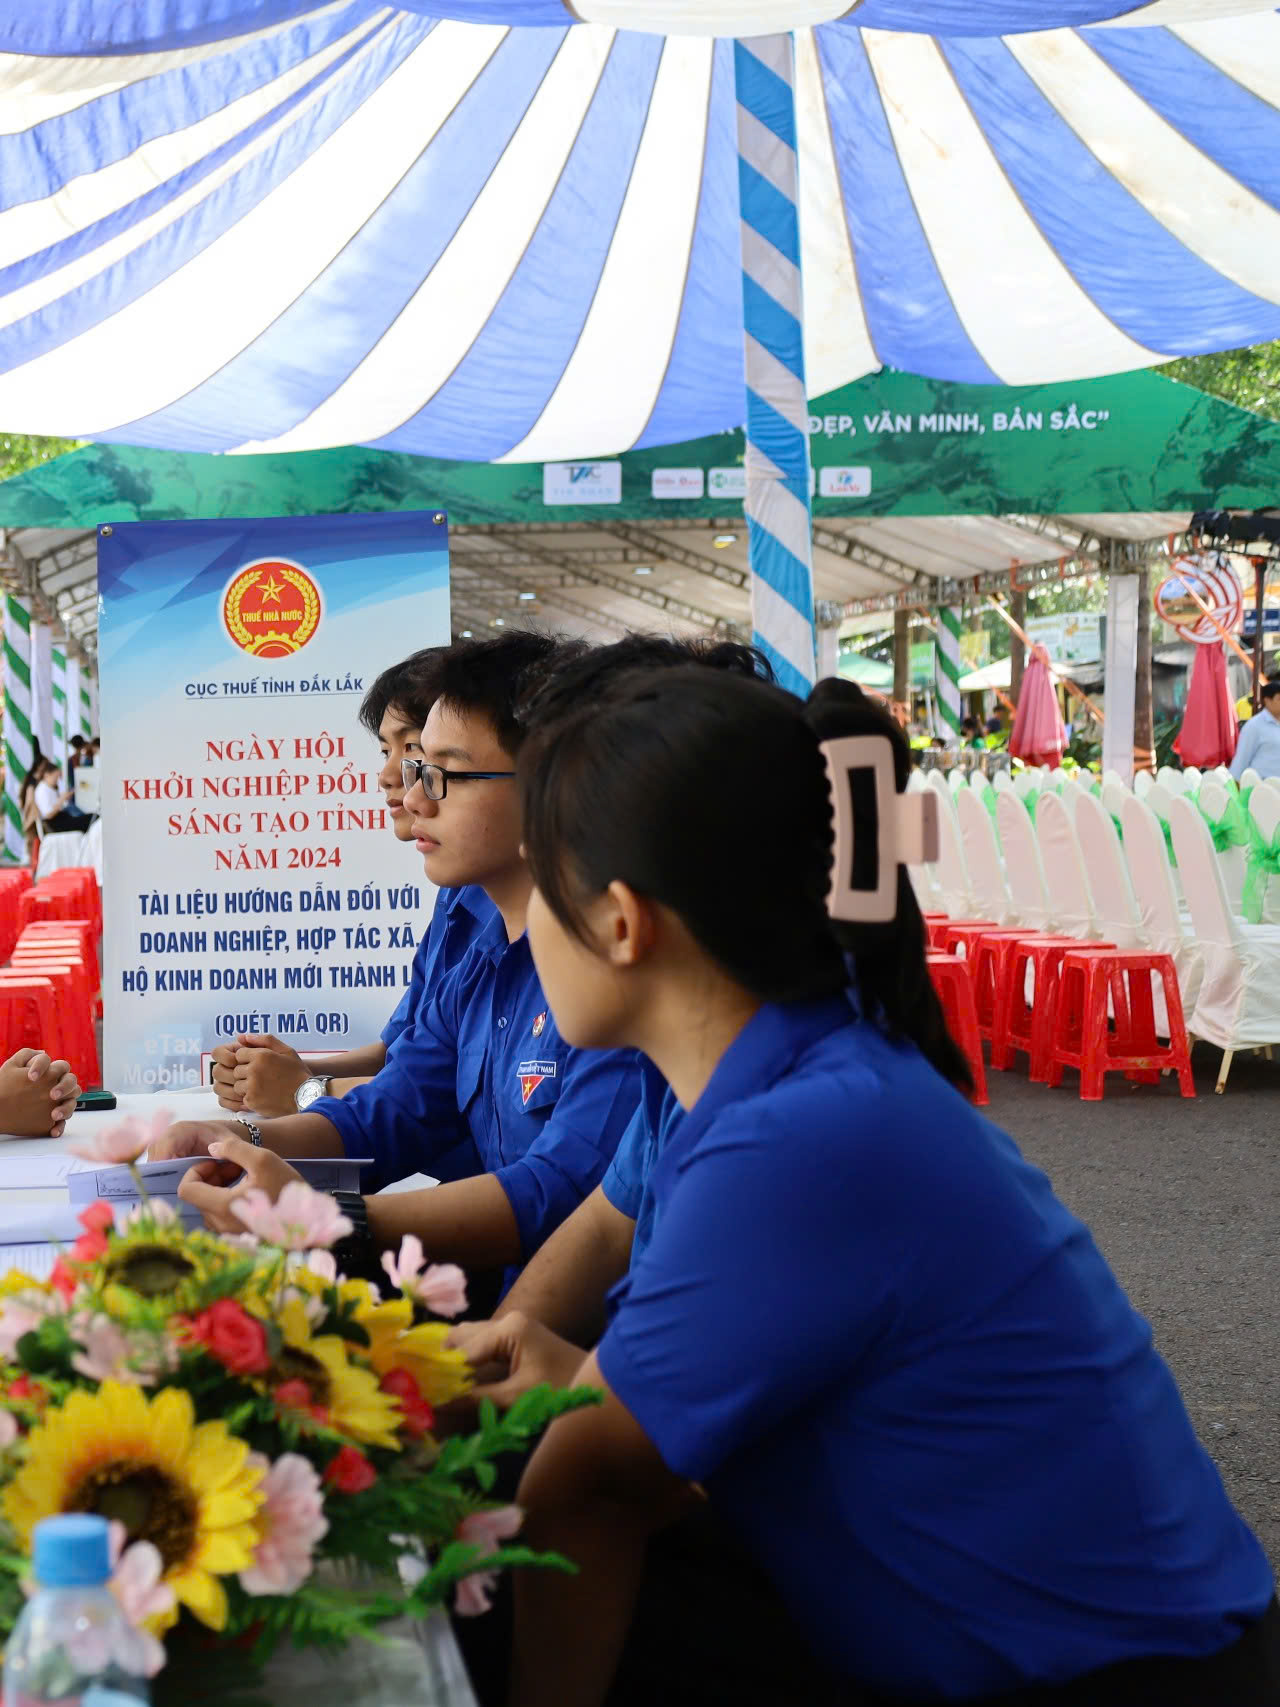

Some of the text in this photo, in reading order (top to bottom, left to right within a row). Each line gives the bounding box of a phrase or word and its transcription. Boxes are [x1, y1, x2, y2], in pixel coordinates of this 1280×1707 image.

[864, 410, 912, 433] VĂN
[920, 413, 986, 435] MINH,
[993, 407, 1043, 432] BẢN
[242, 609, 303, 623] THUẾ NHÀ NƯỚC
[185, 672, 364, 699] CỤC THUẾ TỈNH ĐẮK LẮK
[206, 731, 346, 764] NGÀY HỘI
[121, 771, 193, 800] KHỞI
[202, 769, 310, 801] NGHIỆP
[316, 762, 368, 795] ĐỔI
[168, 803, 387, 838] SÁNG TẠO TỈNH
[215, 843, 342, 870] NĂM 2024
[139, 881, 420, 919] TÀI LIỆU HƯỚNG DẪN ĐỐI VỚI
[140, 931, 207, 954] DOANH
[214, 925, 290, 956] NGHIỆP,
[296, 926, 336, 955] HỢP
[343, 923, 381, 949] TÁC
[122, 965, 148, 996] HỘ
[155, 969, 203, 991] KINH
[210, 967, 277, 990] DOANH
[284, 961, 321, 989] MỚI
[329, 962, 395, 988] THÀNH
[215, 1009, 349, 1036] (QUÉT MÃ QR)
[144, 1033, 201, 1056] eTax
[123, 1063, 200, 1086] Mobile
